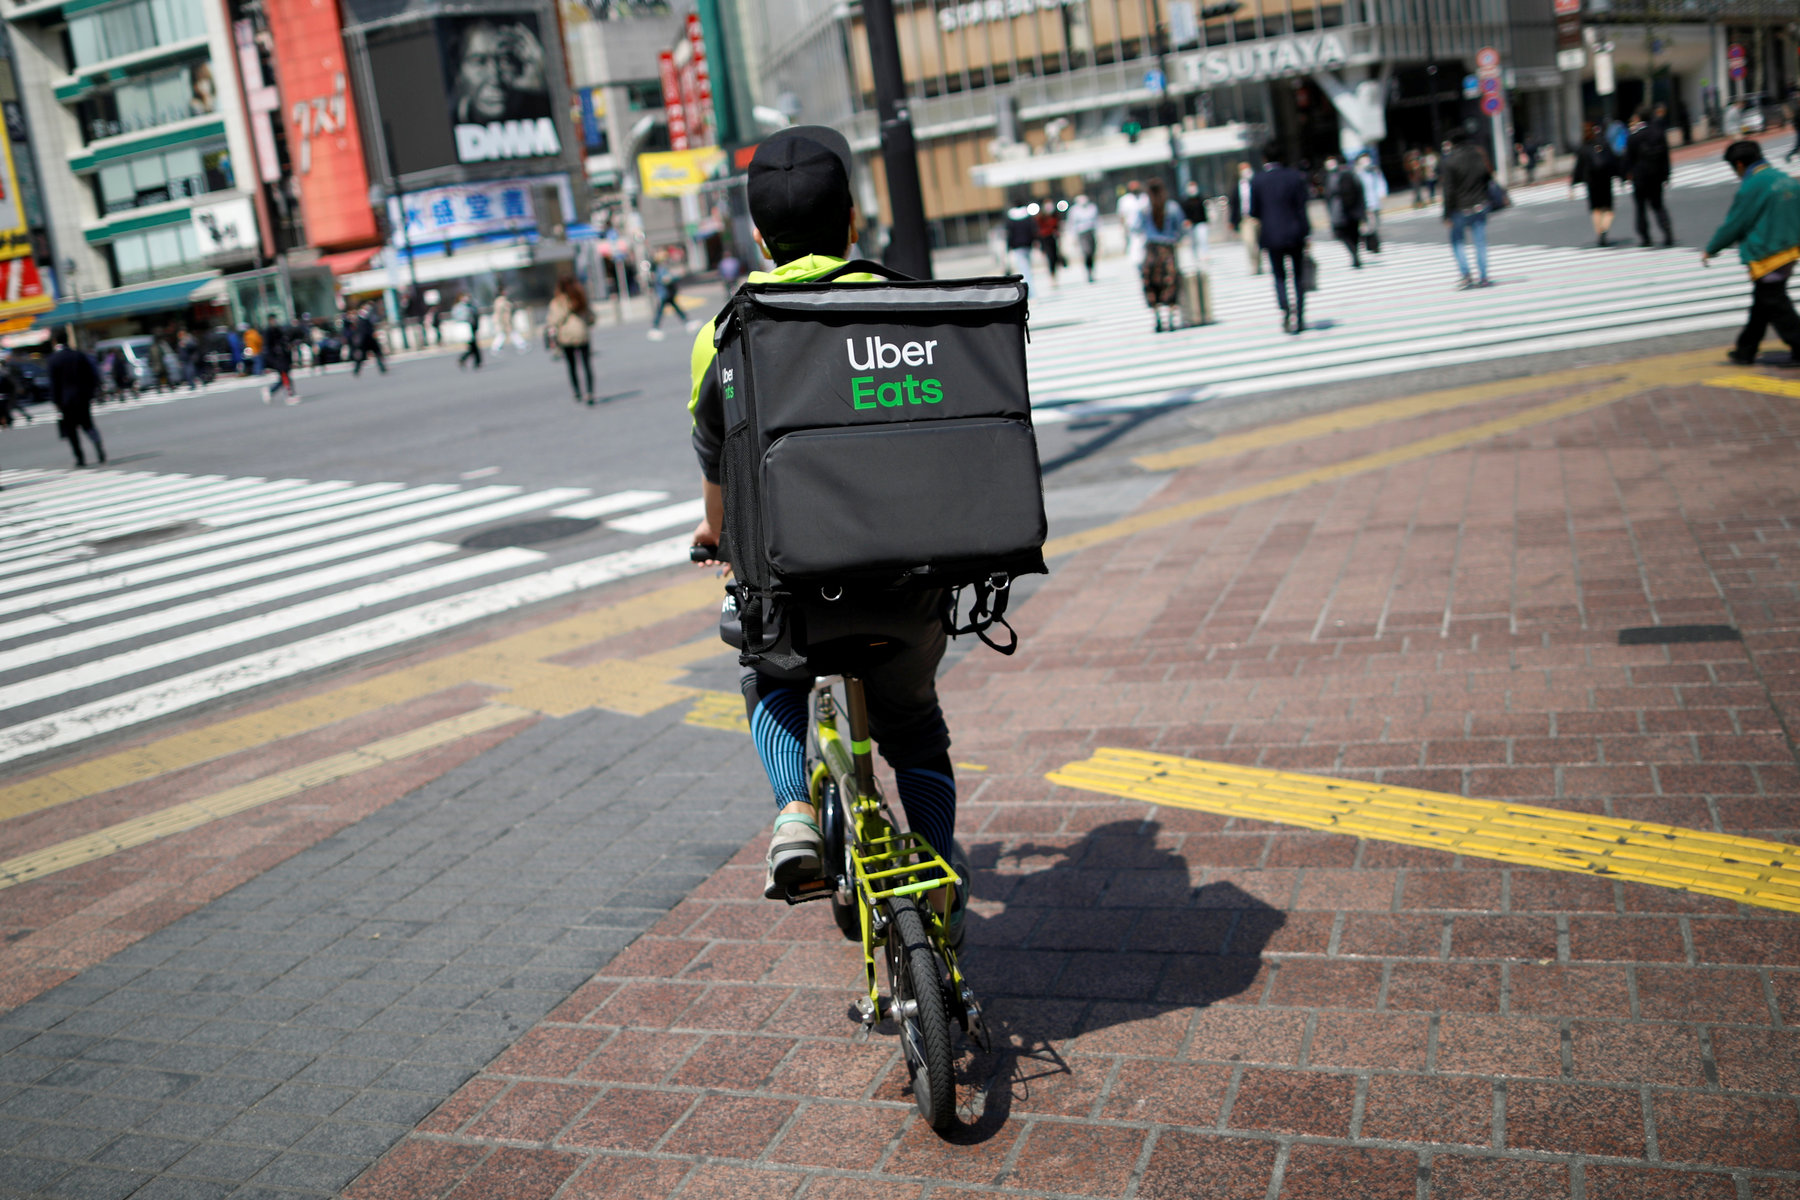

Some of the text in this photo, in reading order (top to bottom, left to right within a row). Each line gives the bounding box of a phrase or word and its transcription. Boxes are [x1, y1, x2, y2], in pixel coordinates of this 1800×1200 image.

[939, 0, 1088, 32] STARBU
[1184, 33, 1346, 83] TSUTAYA
[454, 117, 561, 163] DMM
[846, 335, 938, 371] Uber
[724, 384, 735, 400] ats
[851, 374, 944, 410] Eats
